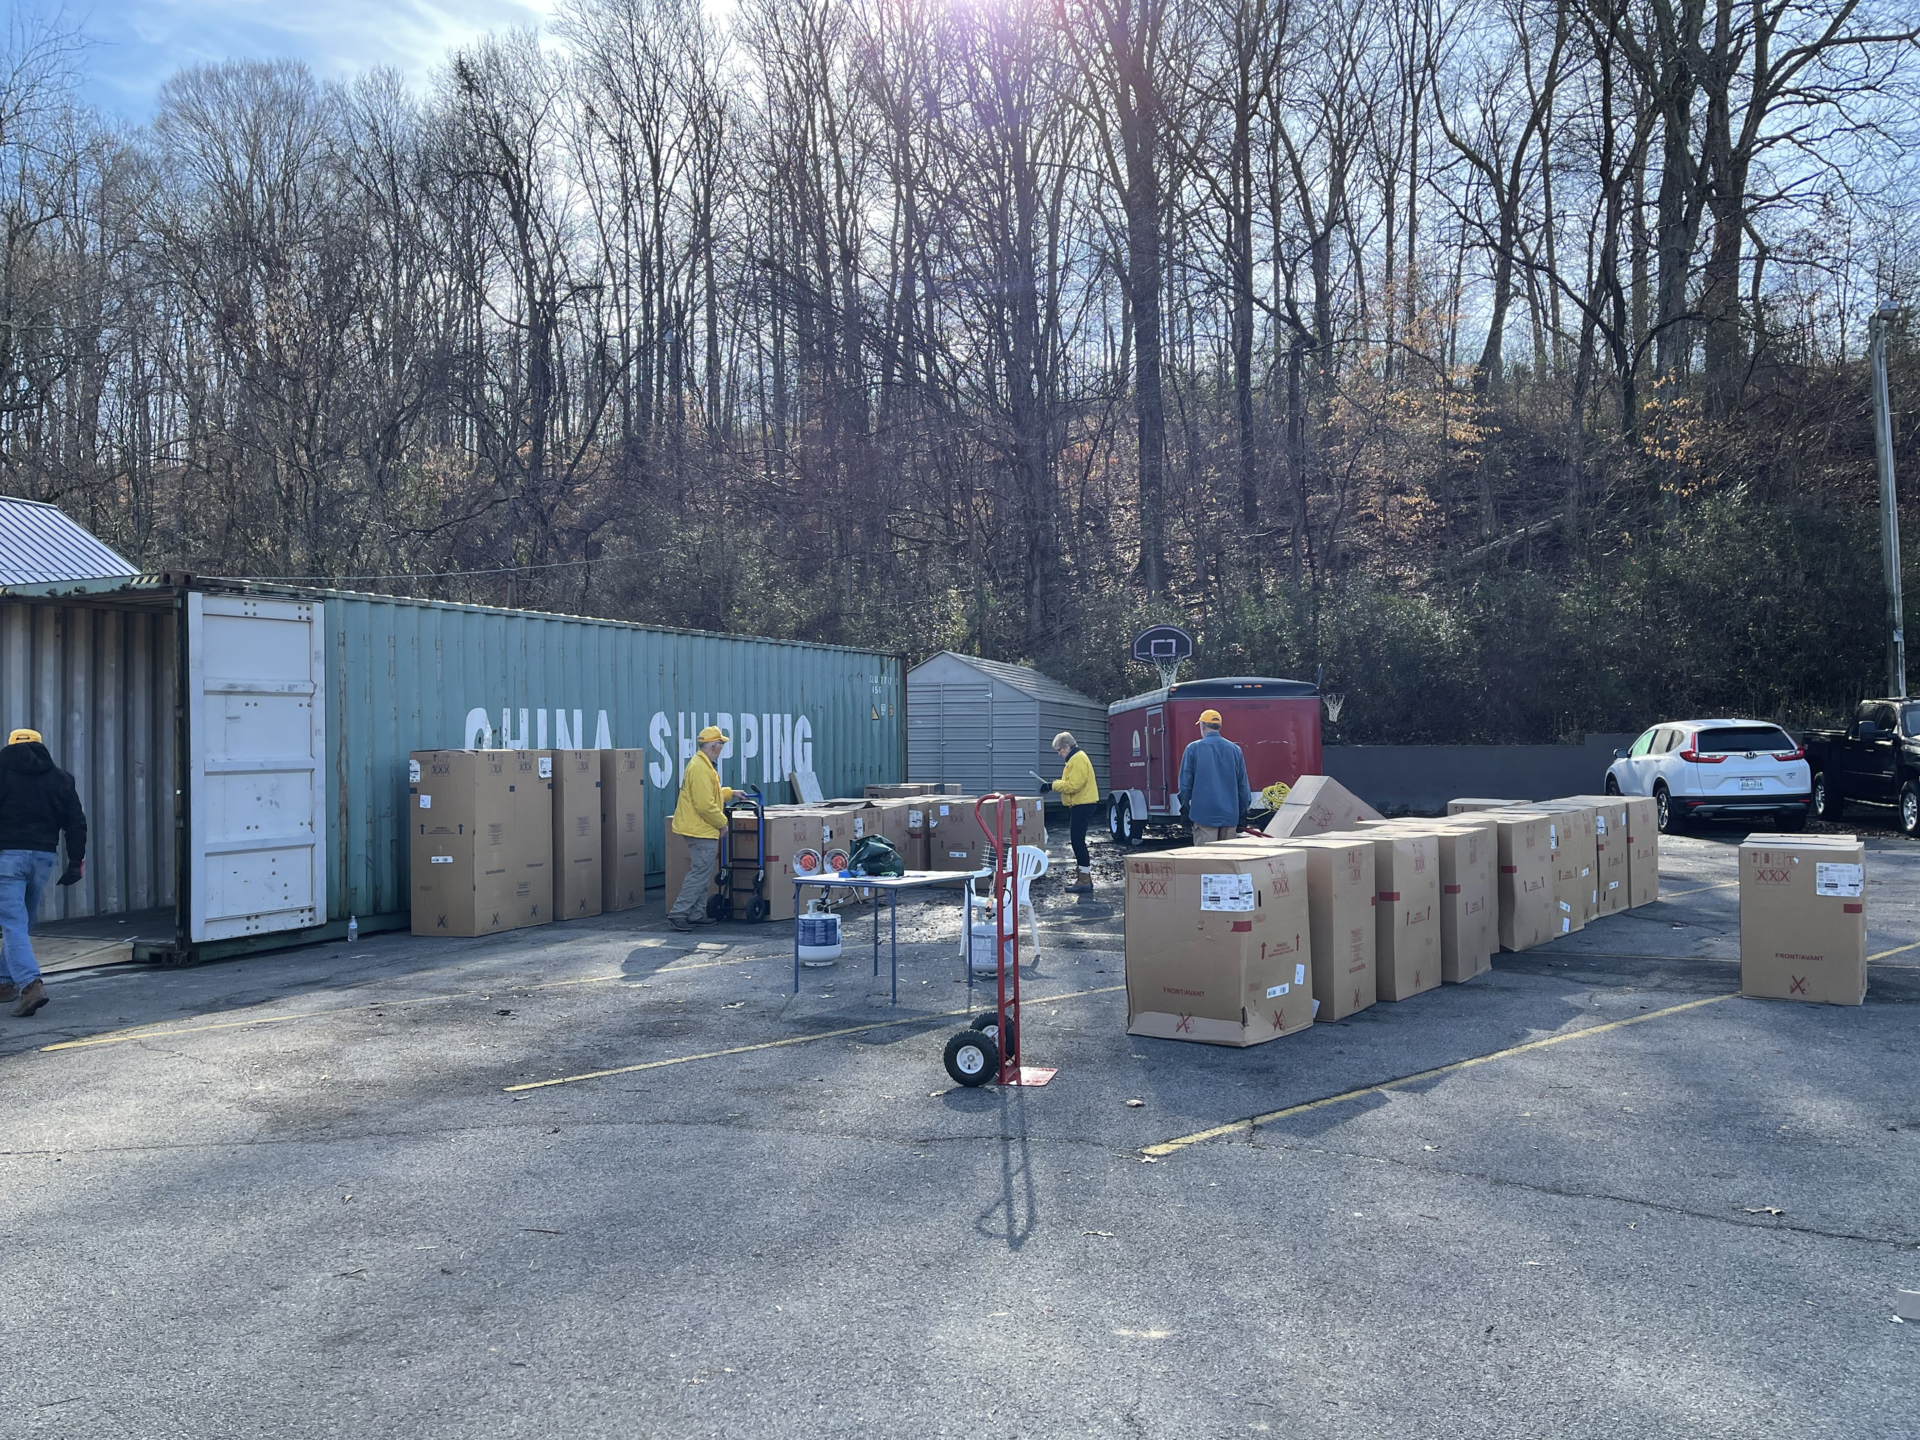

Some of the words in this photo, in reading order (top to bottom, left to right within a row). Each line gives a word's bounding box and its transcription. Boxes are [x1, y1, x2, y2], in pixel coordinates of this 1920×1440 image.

[649, 711, 813, 789] SHPPING
[1775, 952, 1824, 961] FRONT/AVANT
[1163, 986, 1205, 998] FRONT/AVANT
